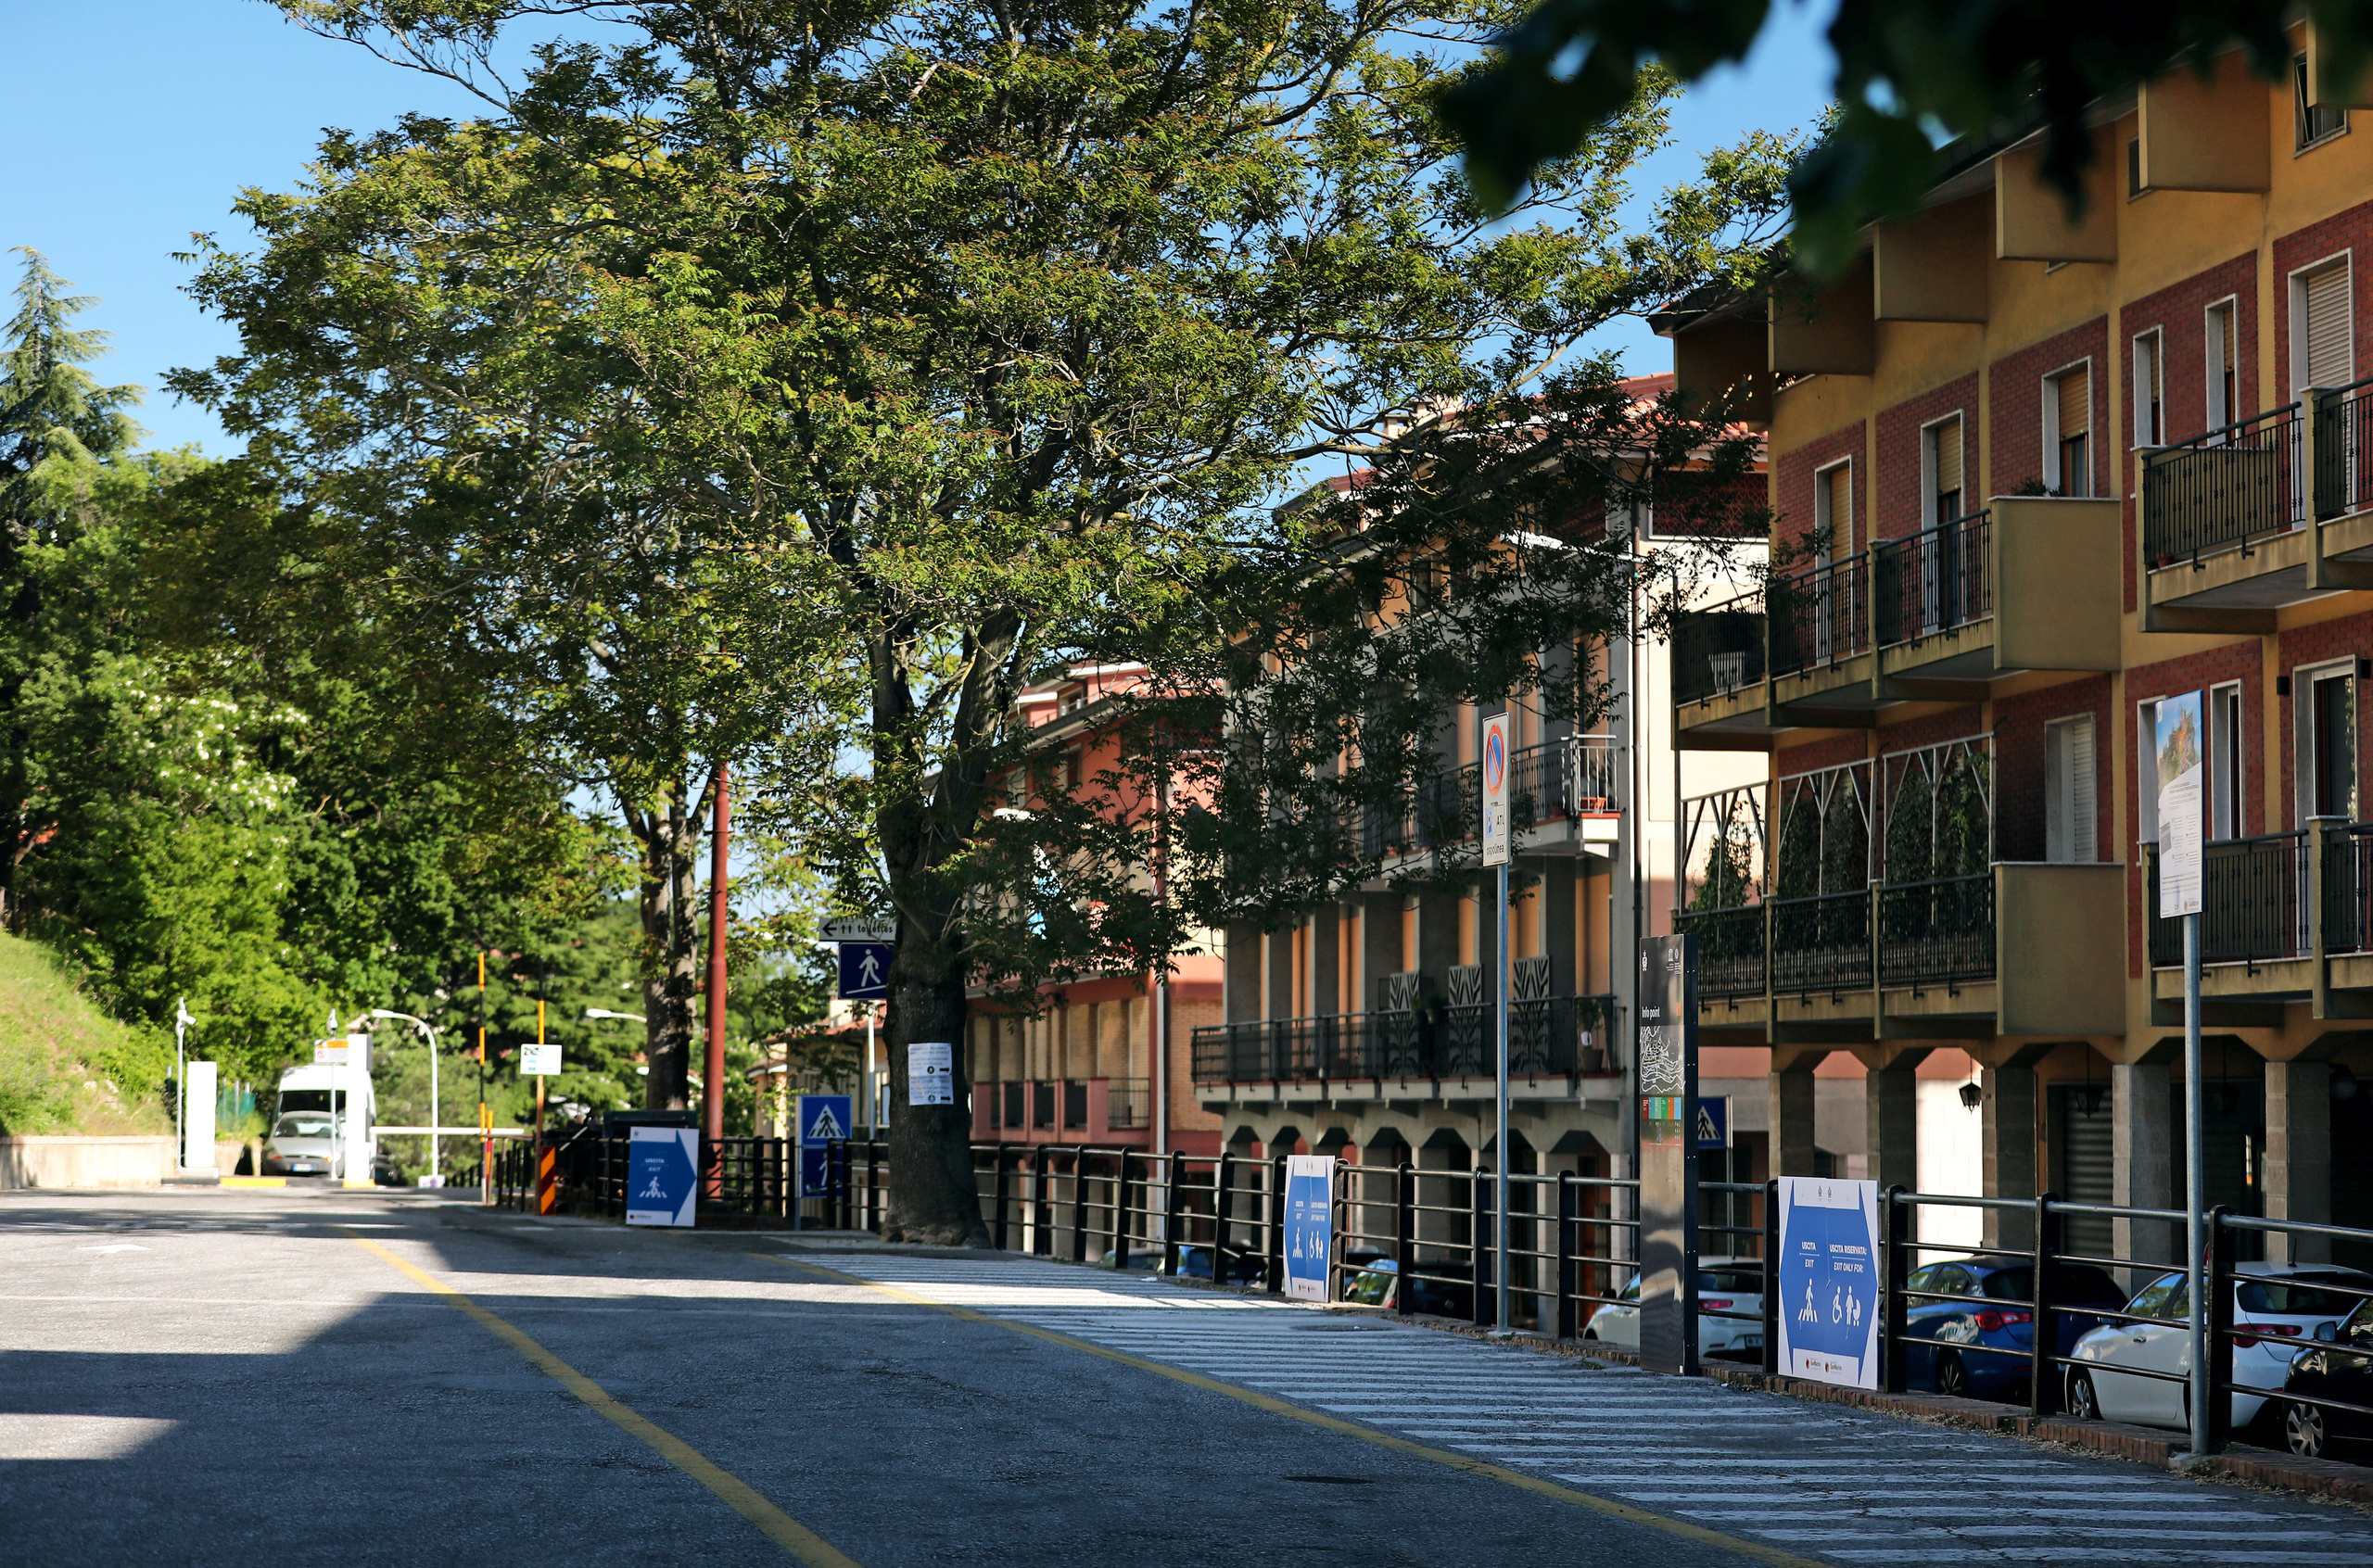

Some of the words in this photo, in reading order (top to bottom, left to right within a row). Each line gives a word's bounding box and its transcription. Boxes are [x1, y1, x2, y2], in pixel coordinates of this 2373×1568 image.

[857, 923, 894, 932] tolettes
[1650, 1005, 1660, 1021] point
[1801, 1241, 1817, 1250] USCITA
[1829, 1244, 1845, 1253] USCITA
[1844, 1246, 1867, 1255] RISERVATA:
[1805, 1258, 1814, 1268] EXIT
[1834, 1262, 1843, 1271] EXIT
[1843, 1263, 1853, 1272] ONLY
[1853, 1263, 1864, 1272] FOR:
